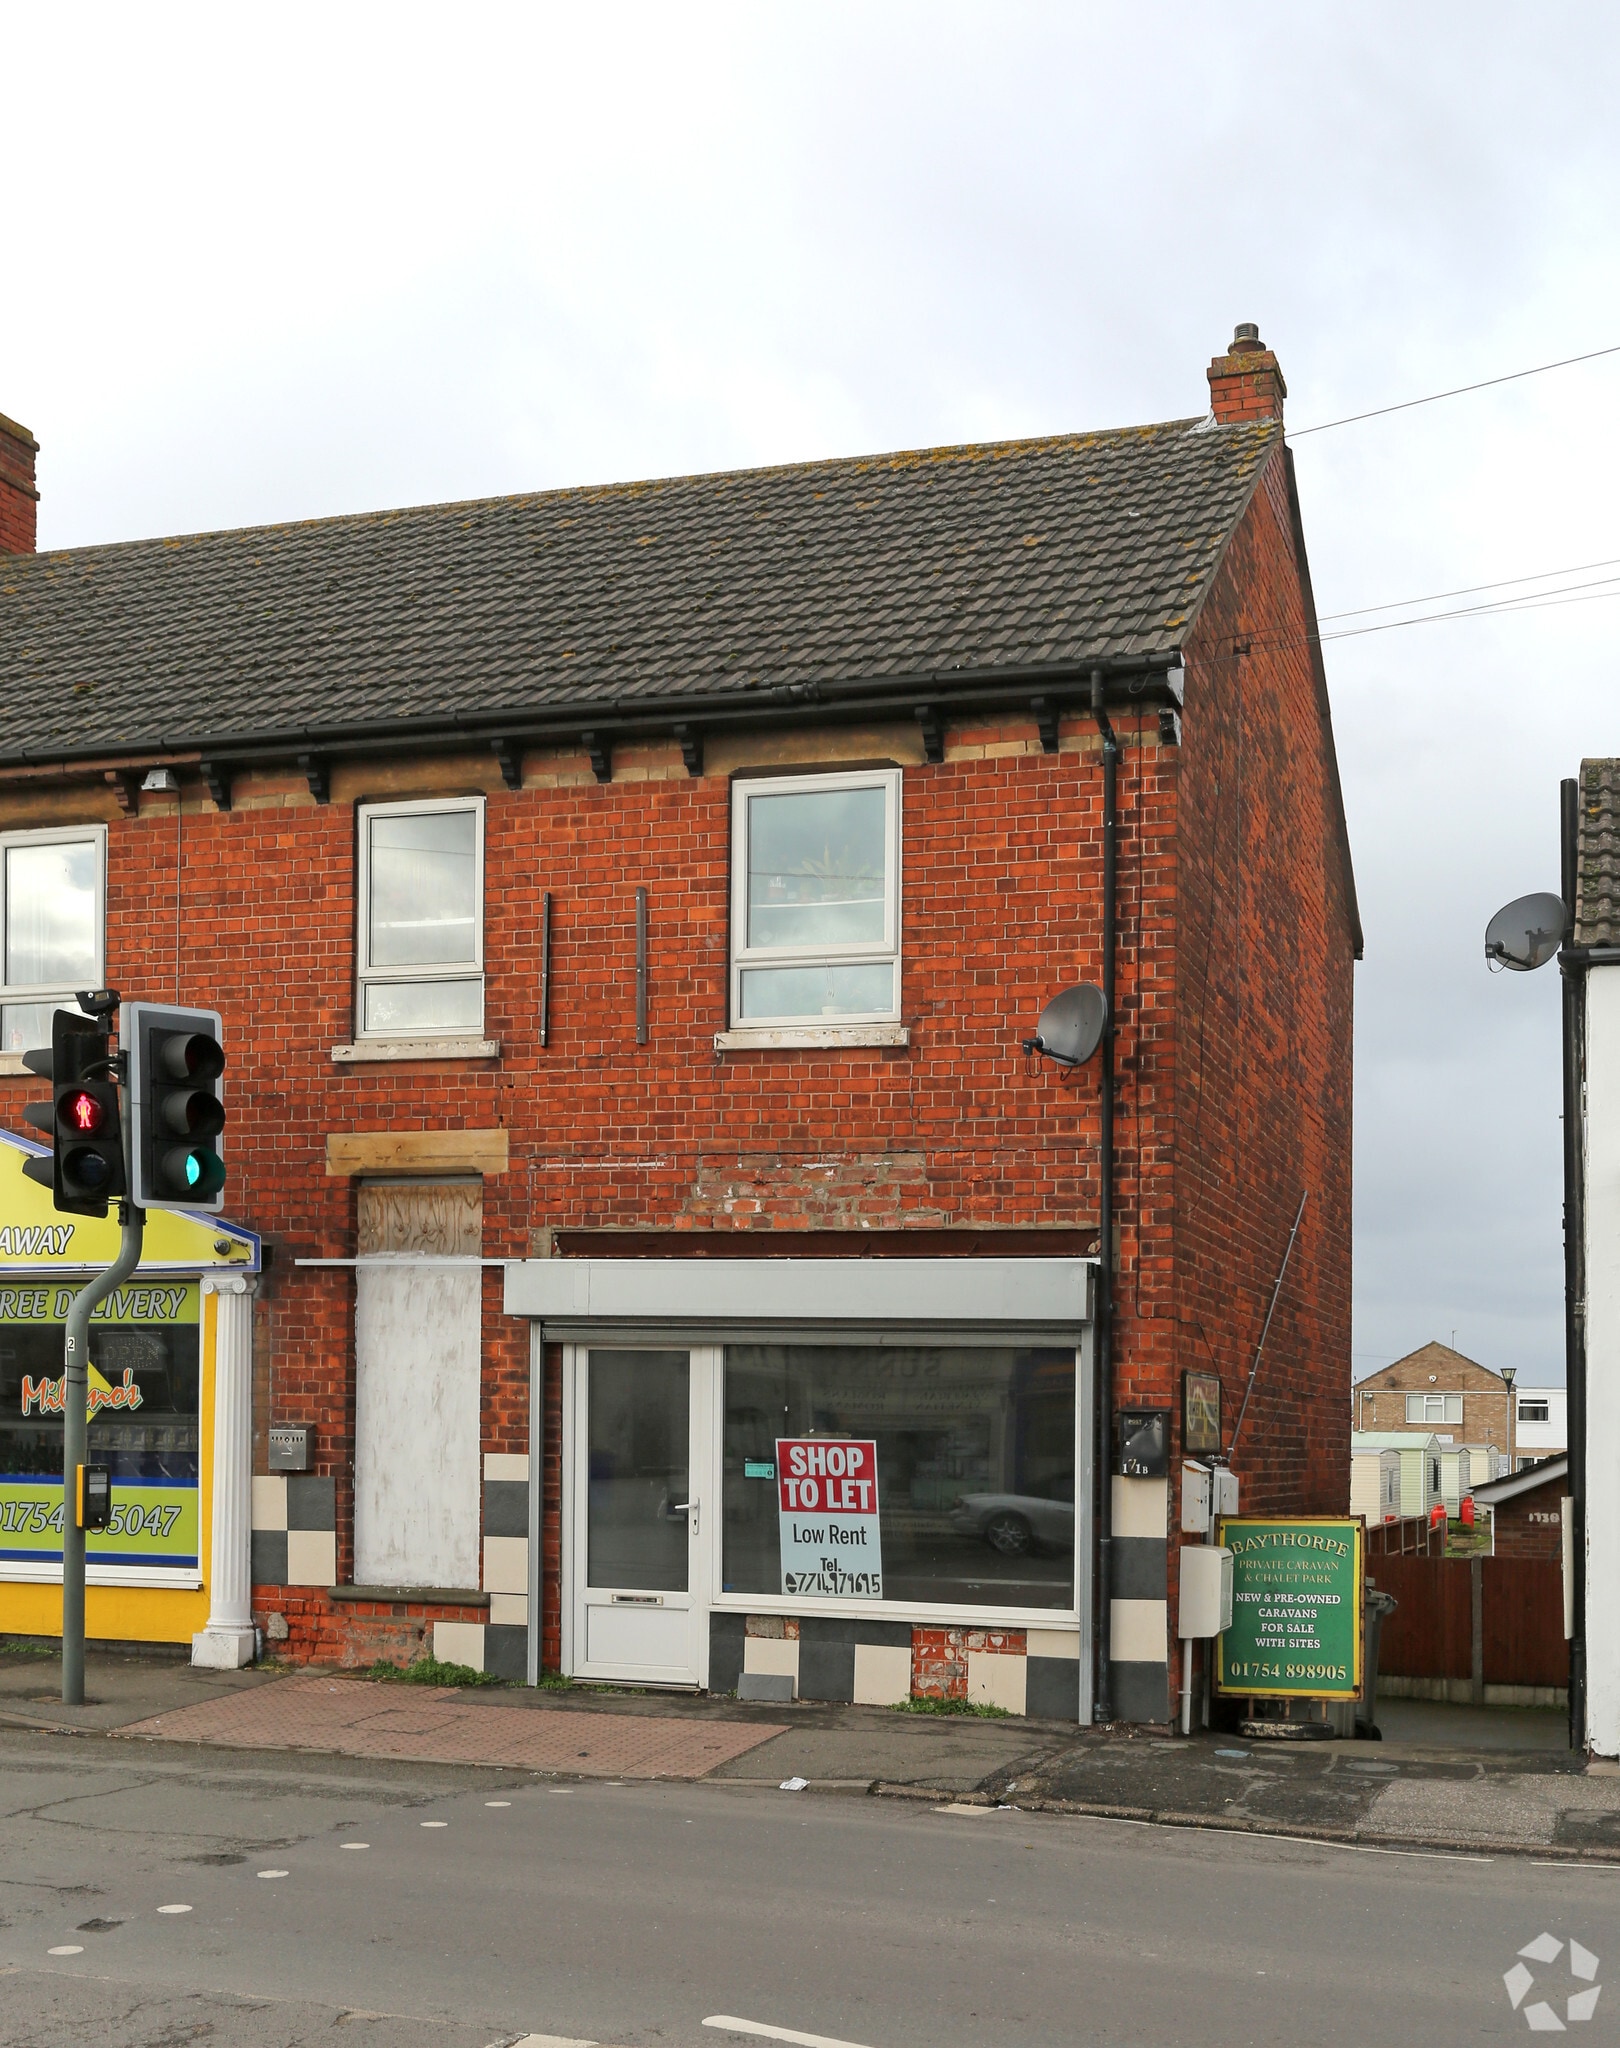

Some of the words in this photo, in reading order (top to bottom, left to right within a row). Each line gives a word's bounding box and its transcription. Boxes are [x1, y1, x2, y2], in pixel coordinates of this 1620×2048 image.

[0, 1224, 75, 1255] AWAY
[0, 1289, 49, 1319] REE
[54, 1287, 187, 1319] DIVERY
[68, 1339, 74, 1350] 2
[22, 1367, 144, 1416] Milno's
[789, 1446, 864, 1477] SHOP
[784, 1478, 819, 1508] TO
[826, 1479, 872, 1510] LET
[0, 1501, 64, 1533] 1754
[793, 1523, 825, 1544] Low
[829, 1524, 867, 1545] Rent
[1231, 1532, 1350, 1558] BAYTHORPE
[820, 1557, 842, 1572] Tel.
[1239, 1560, 1285, 1570] PRIVATE
[1287, 1560, 1339, 1571] CARAVAN
[1244, 1573, 1253, 1583] &
[1255, 1573, 1300, 1583] CHALET
[1302, 1574, 1332, 1584] PARK
[1236, 1592, 1262, 1602] NEW
[1264, 1593, 1272, 1603] &
[1273, 1593, 1341, 1605] PRE-OWNED
[1258, 1608, 1318, 1619] CARAVANS
[1261, 1623, 1284, 1633] FOR
[1287, 1623, 1315, 1634] SALE
[1254, 1637, 1286, 1648] WITH
[1289, 1638, 1321, 1649] SITES
[1231, 1661, 1281, 1678] 01754
[1286, 1663, 1347, 1681] 898905
